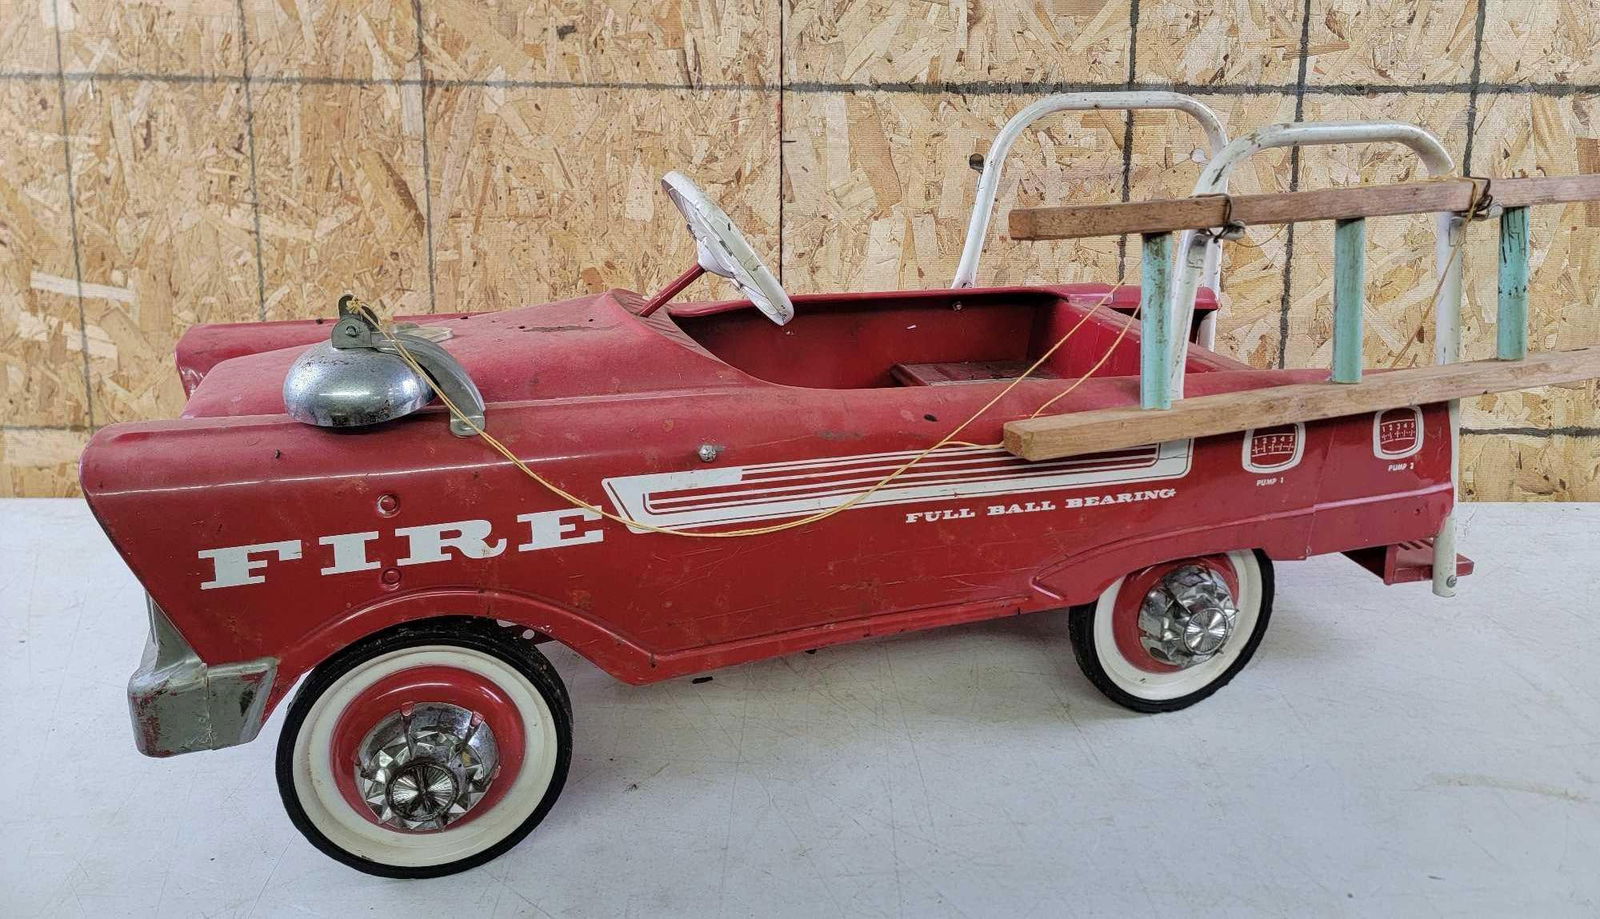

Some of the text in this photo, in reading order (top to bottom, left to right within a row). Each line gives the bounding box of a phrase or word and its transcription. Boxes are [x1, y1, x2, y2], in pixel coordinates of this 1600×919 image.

[1387, 463, 1408, 472] PUMP
[1256, 478, 1278, 487] PUMP
[905, 488, 1177, 524] FULL BALL BEARING
[198, 505, 604, 590] FIRE
